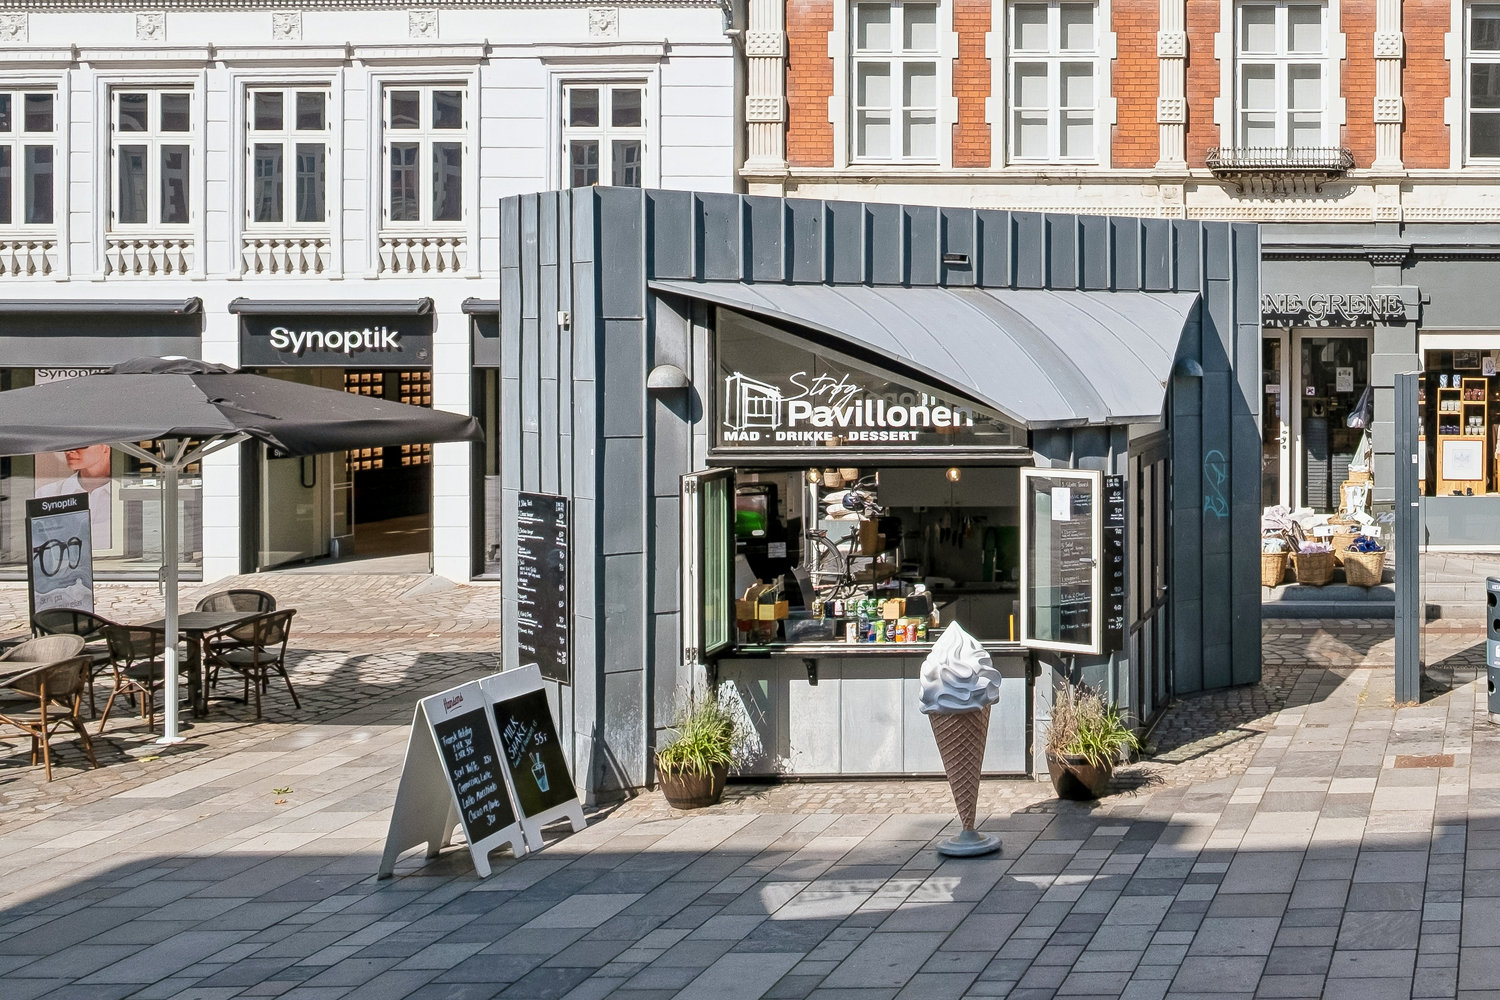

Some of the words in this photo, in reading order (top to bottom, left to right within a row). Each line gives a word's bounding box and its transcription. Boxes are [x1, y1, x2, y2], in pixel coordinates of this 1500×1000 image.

[1261, 293, 1300, 314] NE
[1308, 293, 1403, 321] GRENE
[270, 326, 399, 353] Synoptik
[38, 368, 95, 379] Synop
[785, 372, 862, 412] Strøg
[788, 399, 974, 427] Pavillonen
[724, 431, 760, 441] MAD
[775, 431, 833, 441] DRIKKE
[848, 431, 919, 441] DESSERT
[41, 497, 78, 511] Synoptik
[504, 715, 519, 745] MILK
[508, 721, 528, 760] SHAKE
